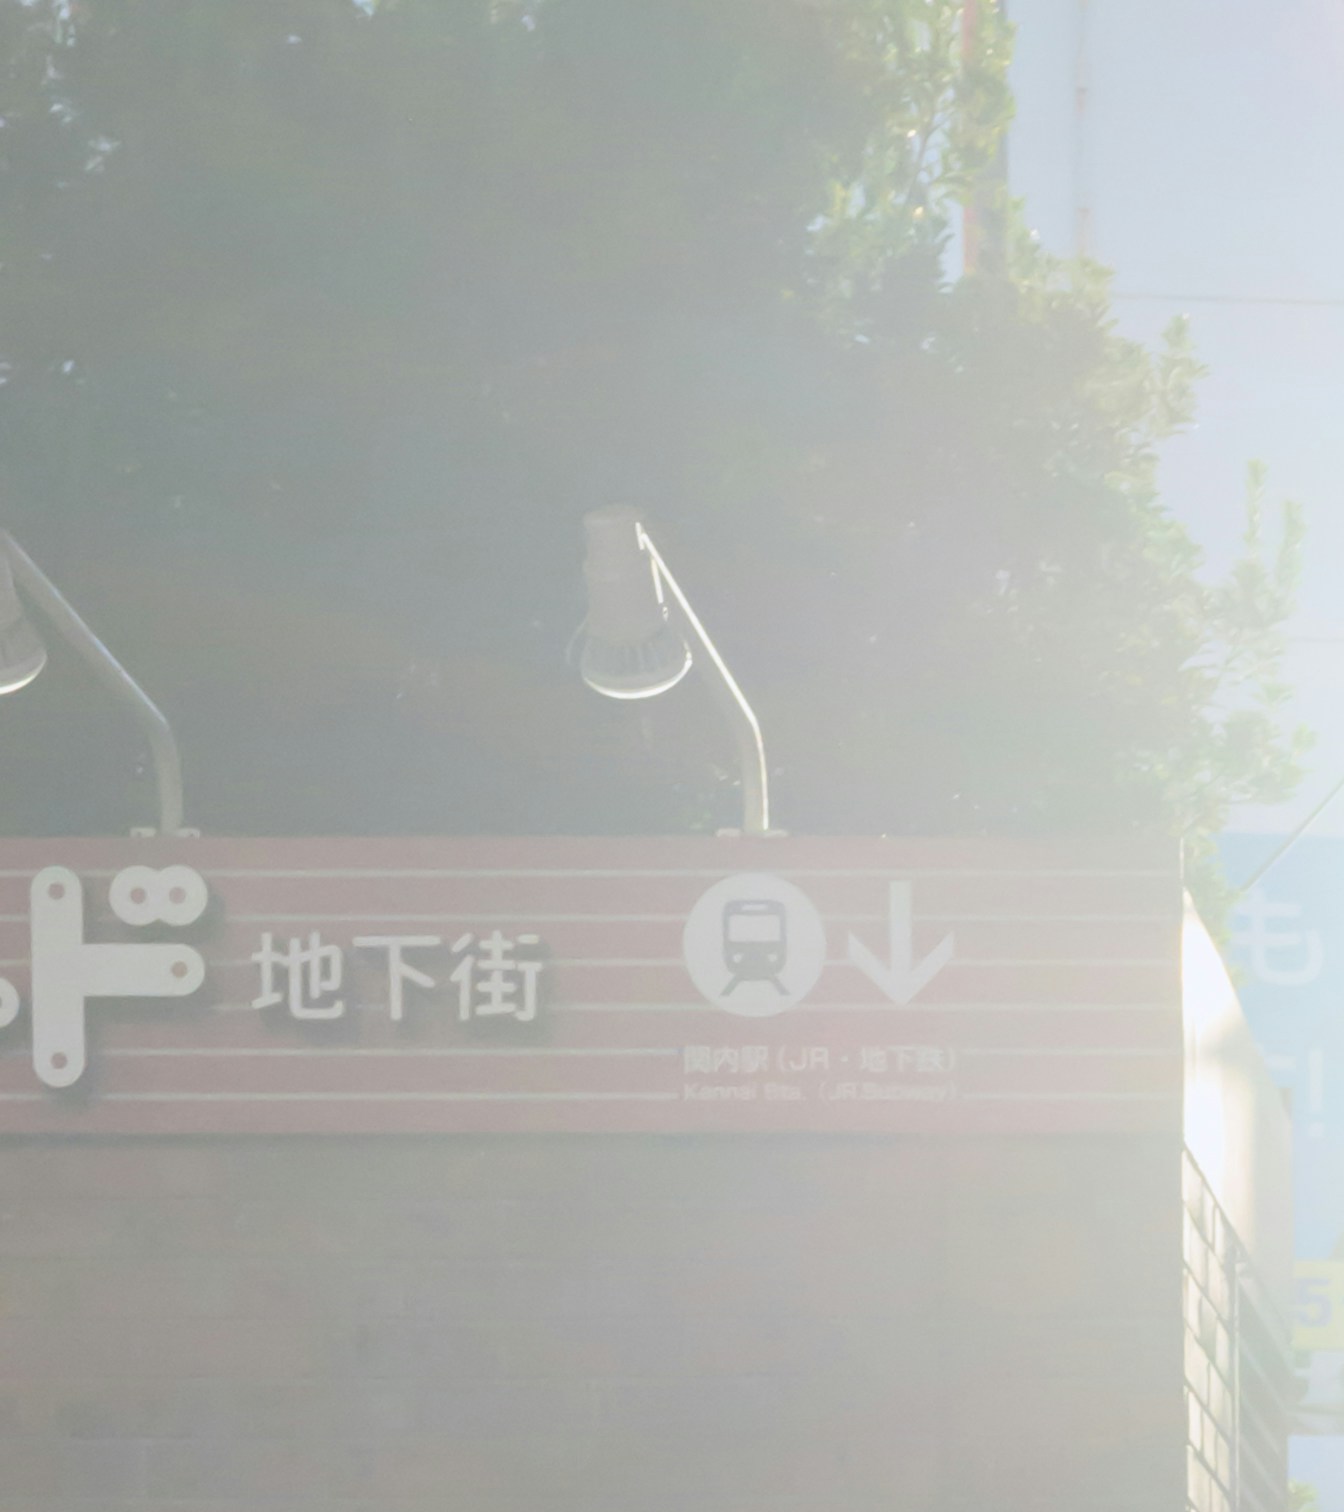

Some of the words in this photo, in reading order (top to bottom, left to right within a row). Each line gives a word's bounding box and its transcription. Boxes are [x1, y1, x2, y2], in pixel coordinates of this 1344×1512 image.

[0, 865, 208, 1088] ド
[252, 930, 543, 1021] 地下街
[683, 1082, 756, 1102] Kannai
